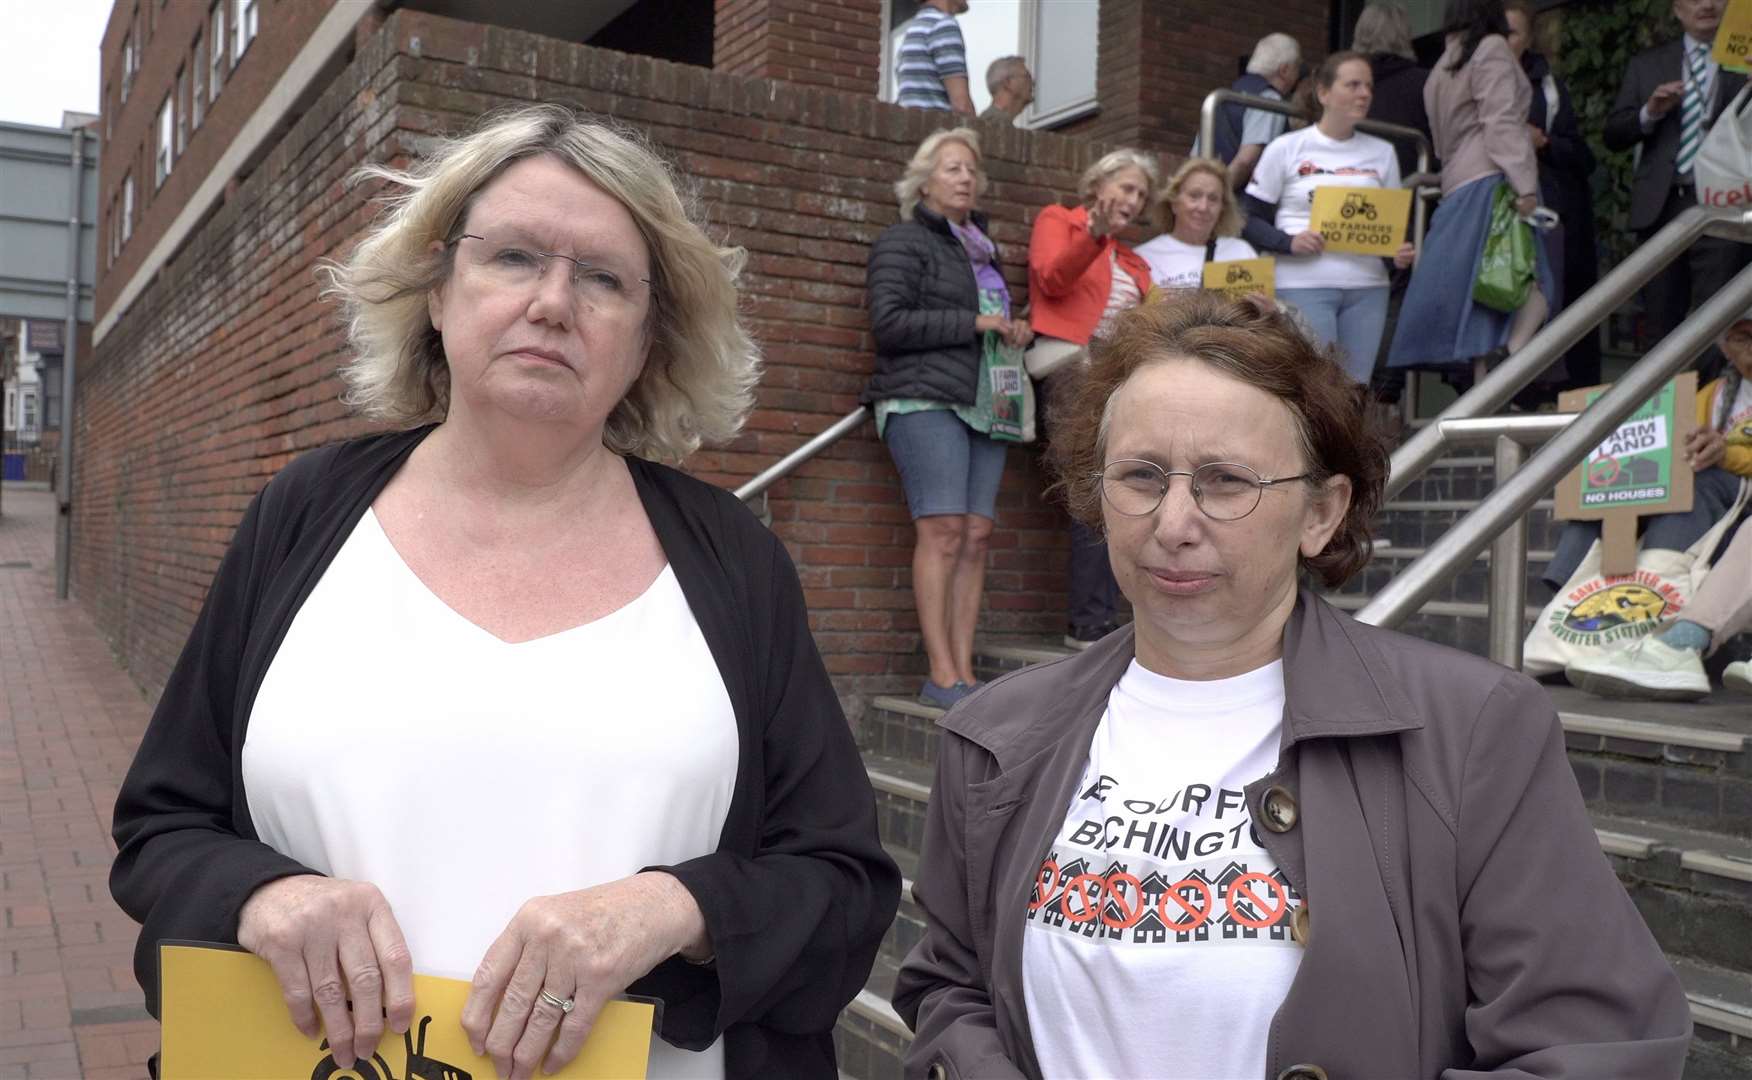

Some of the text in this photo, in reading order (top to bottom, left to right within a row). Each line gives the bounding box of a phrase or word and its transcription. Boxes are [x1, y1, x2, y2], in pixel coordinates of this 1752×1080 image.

[1320, 221, 1392, 233] NO FARMERS
[1320, 231, 1391, 246] NO FOOD
[1608, 422, 1656, 444] ARM
[1585, 487, 1665, 503] NO HOUSES
